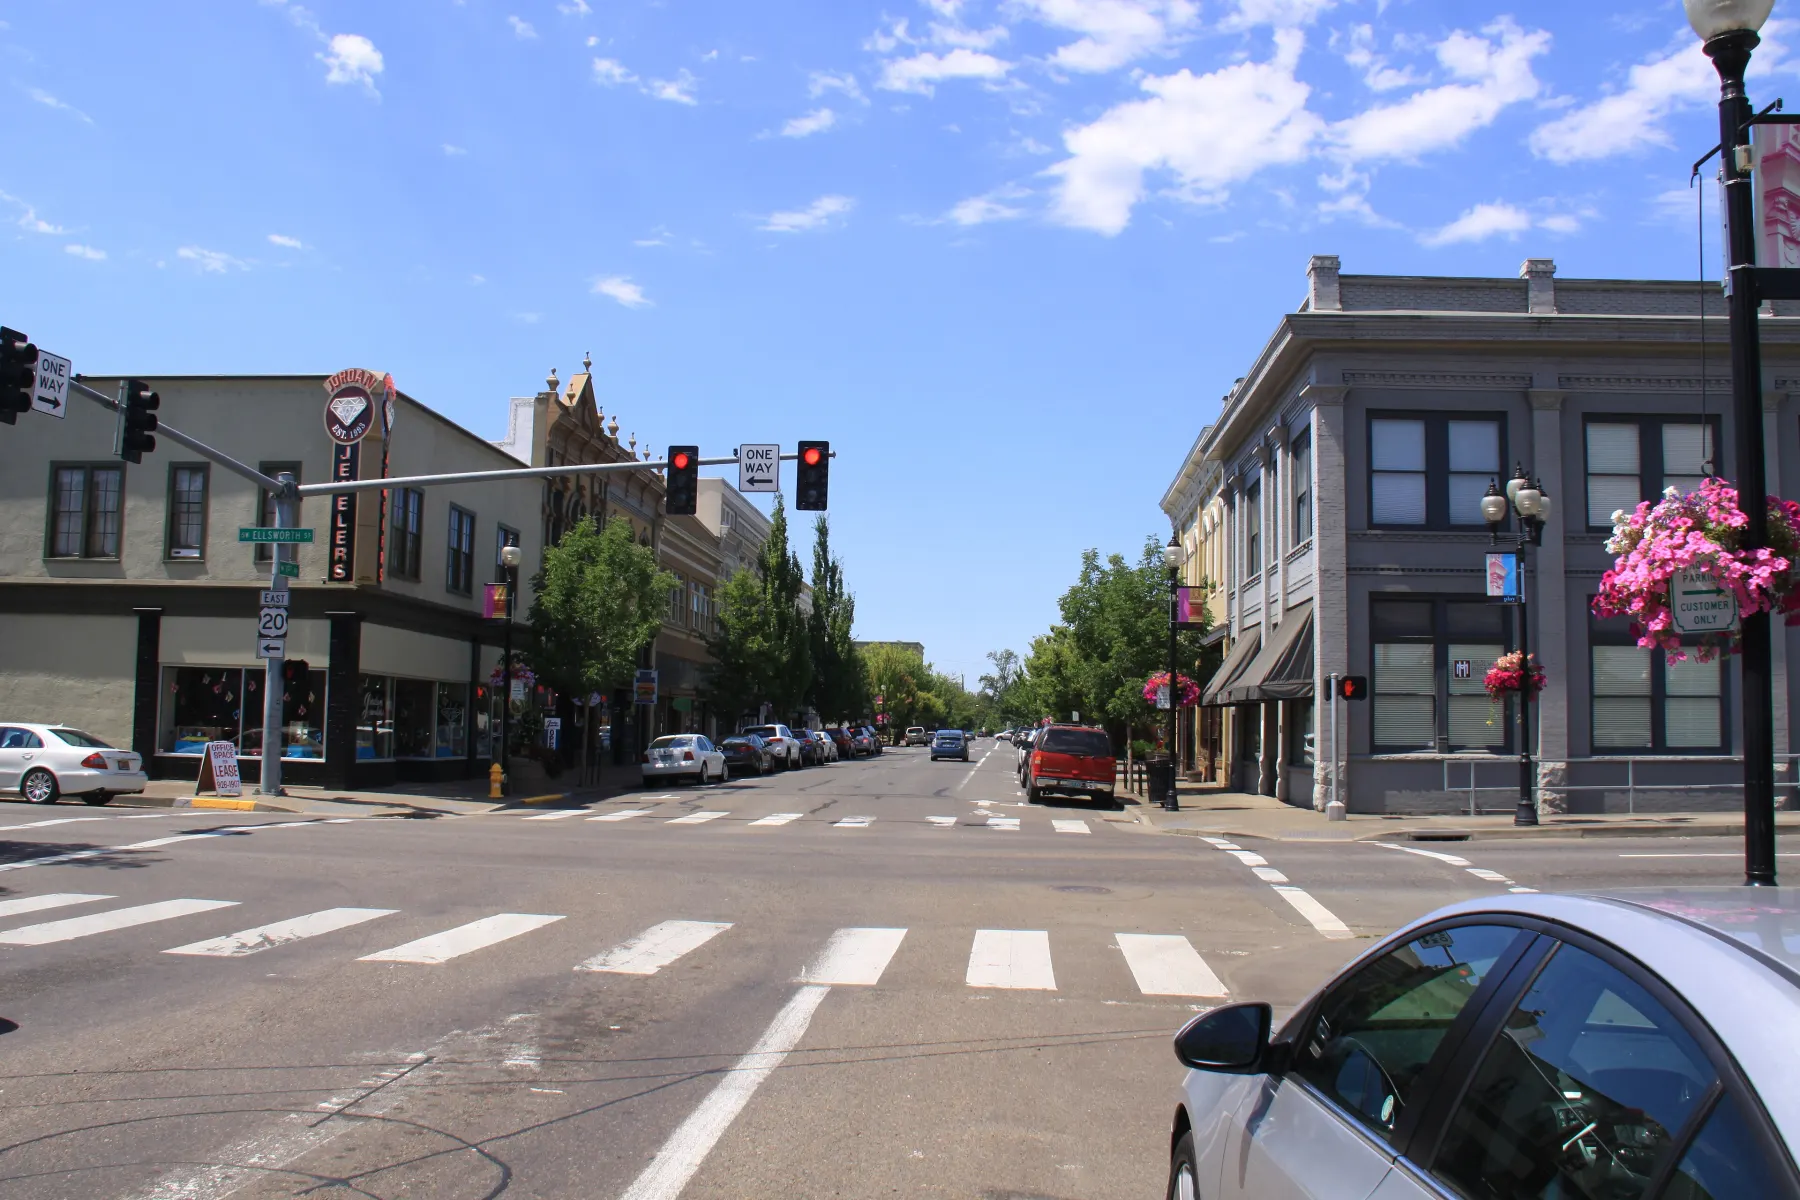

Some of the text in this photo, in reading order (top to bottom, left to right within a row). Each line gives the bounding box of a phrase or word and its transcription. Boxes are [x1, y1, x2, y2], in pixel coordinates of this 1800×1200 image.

[42, 358, 65, 377] ONE
[40, 374, 64, 393] WAY
[328, 368, 377, 393] JORDAN
[331, 423, 347, 440] EST.
[746, 449, 773, 460] ONE
[745, 462, 774, 474] WAY
[333, 445, 352, 579] JEELERS
[252, 530, 301, 540] ELLSWORTH
[1682, 573, 1718, 584] PARKIN
[264, 592, 286, 604] EAST
[1680, 600, 1730, 612] CUSTOMER
[262, 612, 285, 631] 20
[1693, 614, 1718, 625] ONLY
[211, 743, 235, 752] OFFICE
[213, 751, 235, 759] SPACE
[214, 764, 239, 778] LEASE
